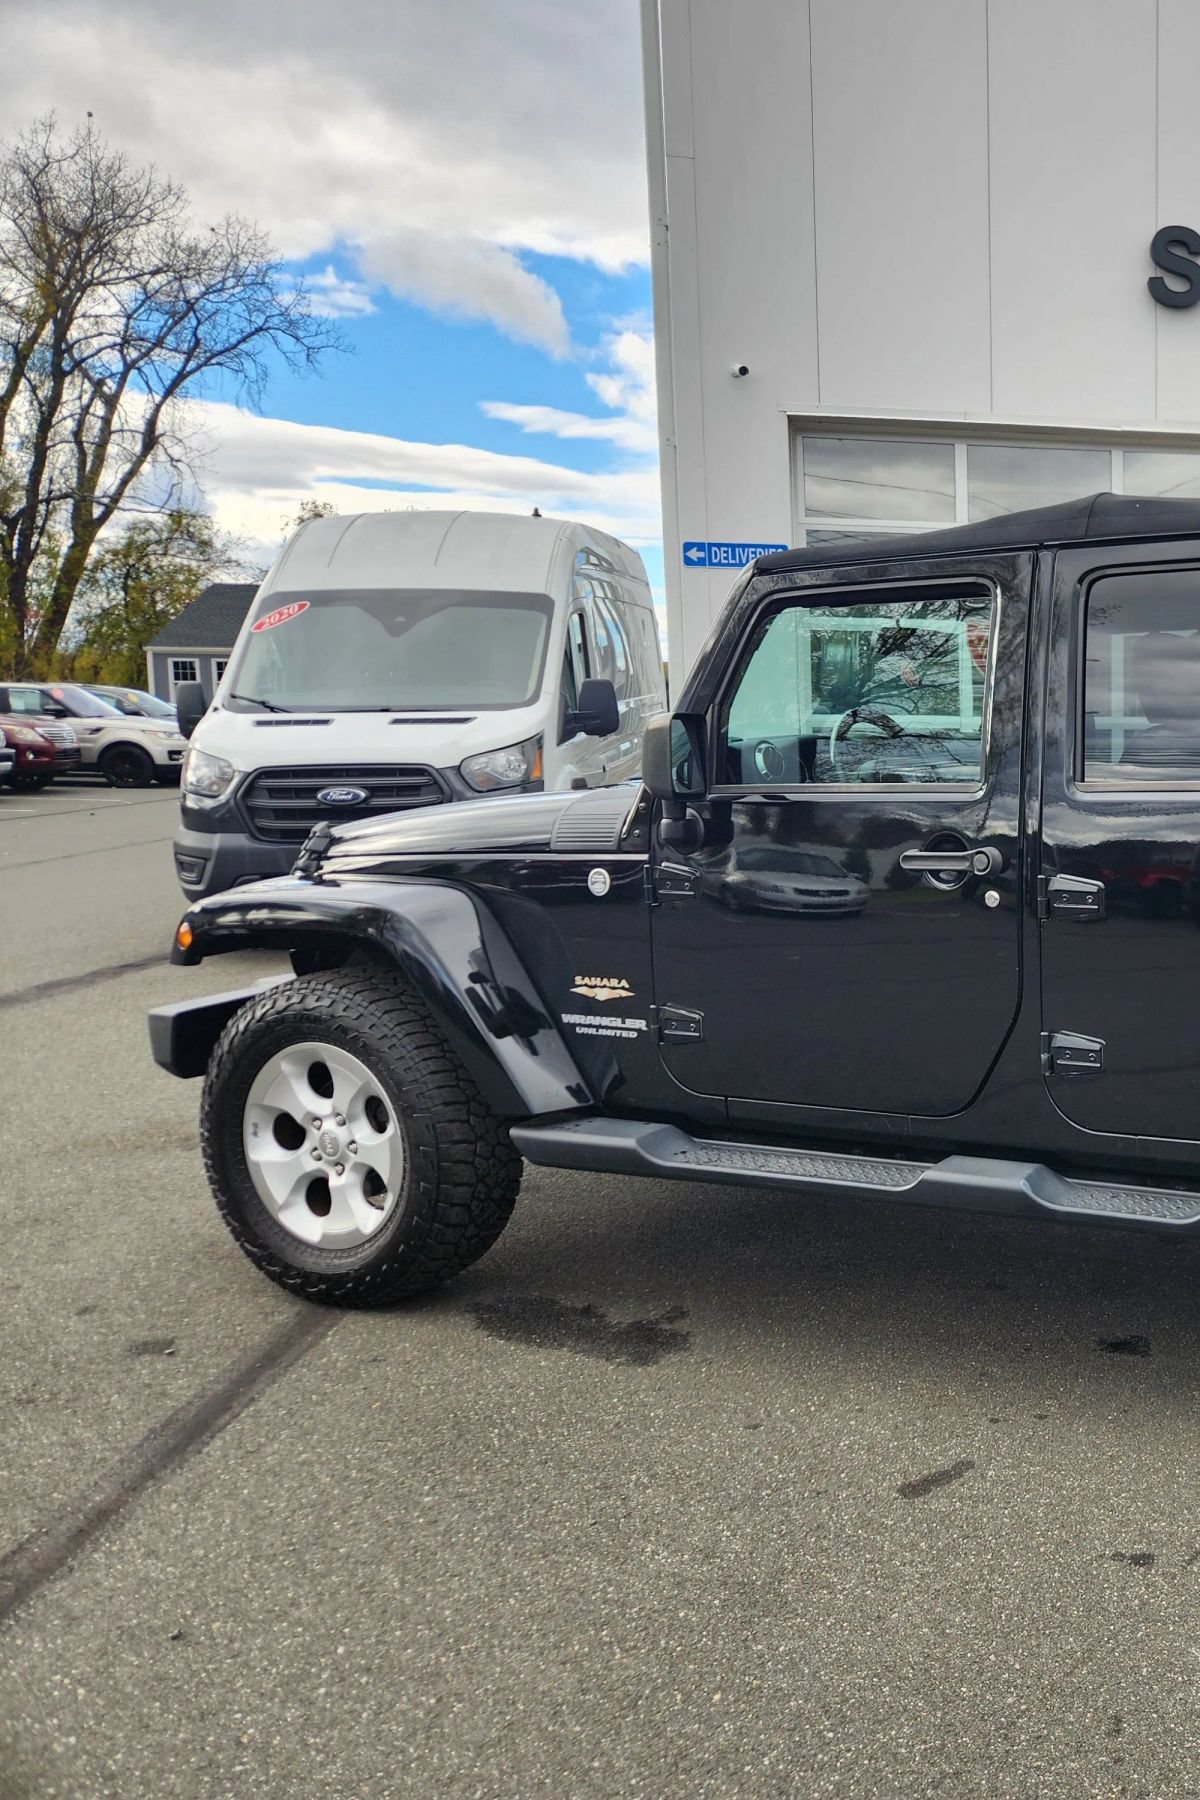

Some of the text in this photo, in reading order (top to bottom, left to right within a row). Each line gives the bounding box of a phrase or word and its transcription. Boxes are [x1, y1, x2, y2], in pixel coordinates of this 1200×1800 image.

[263, 604, 299, 628] 2020
[327, 790, 355, 801] Ford
[574, 975, 630, 988] SAHARA
[561, 1013, 648, 1031] WRANGLER
[575, 1026, 638, 1039] UNLIMITED
